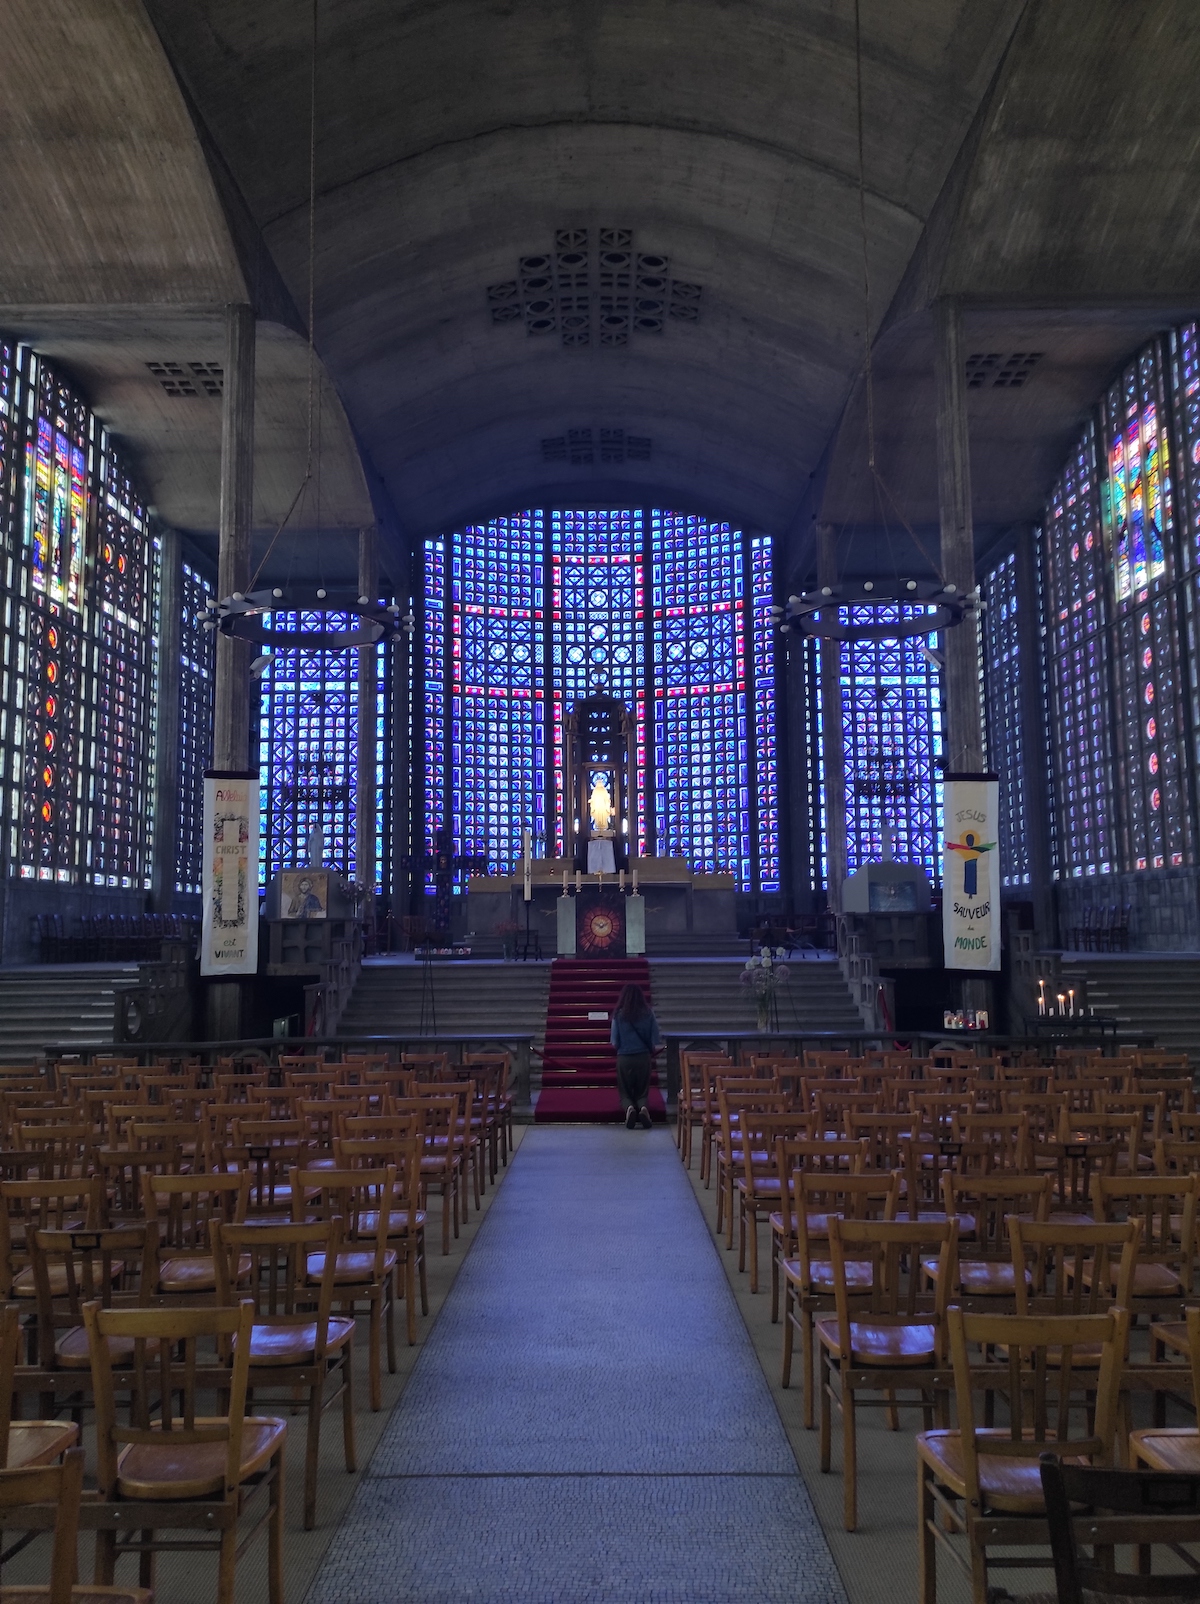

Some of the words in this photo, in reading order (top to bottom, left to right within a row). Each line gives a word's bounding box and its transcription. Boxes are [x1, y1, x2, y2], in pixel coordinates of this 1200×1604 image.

[955, 810, 986, 823] JESUS
[216, 845, 246, 855] CHRIST
[953, 901, 990, 919] SAUVEUR
[223, 938, 236, 947] est
[954, 936, 987, 950] MONDE
[215, 949, 244, 959] VIVANT
